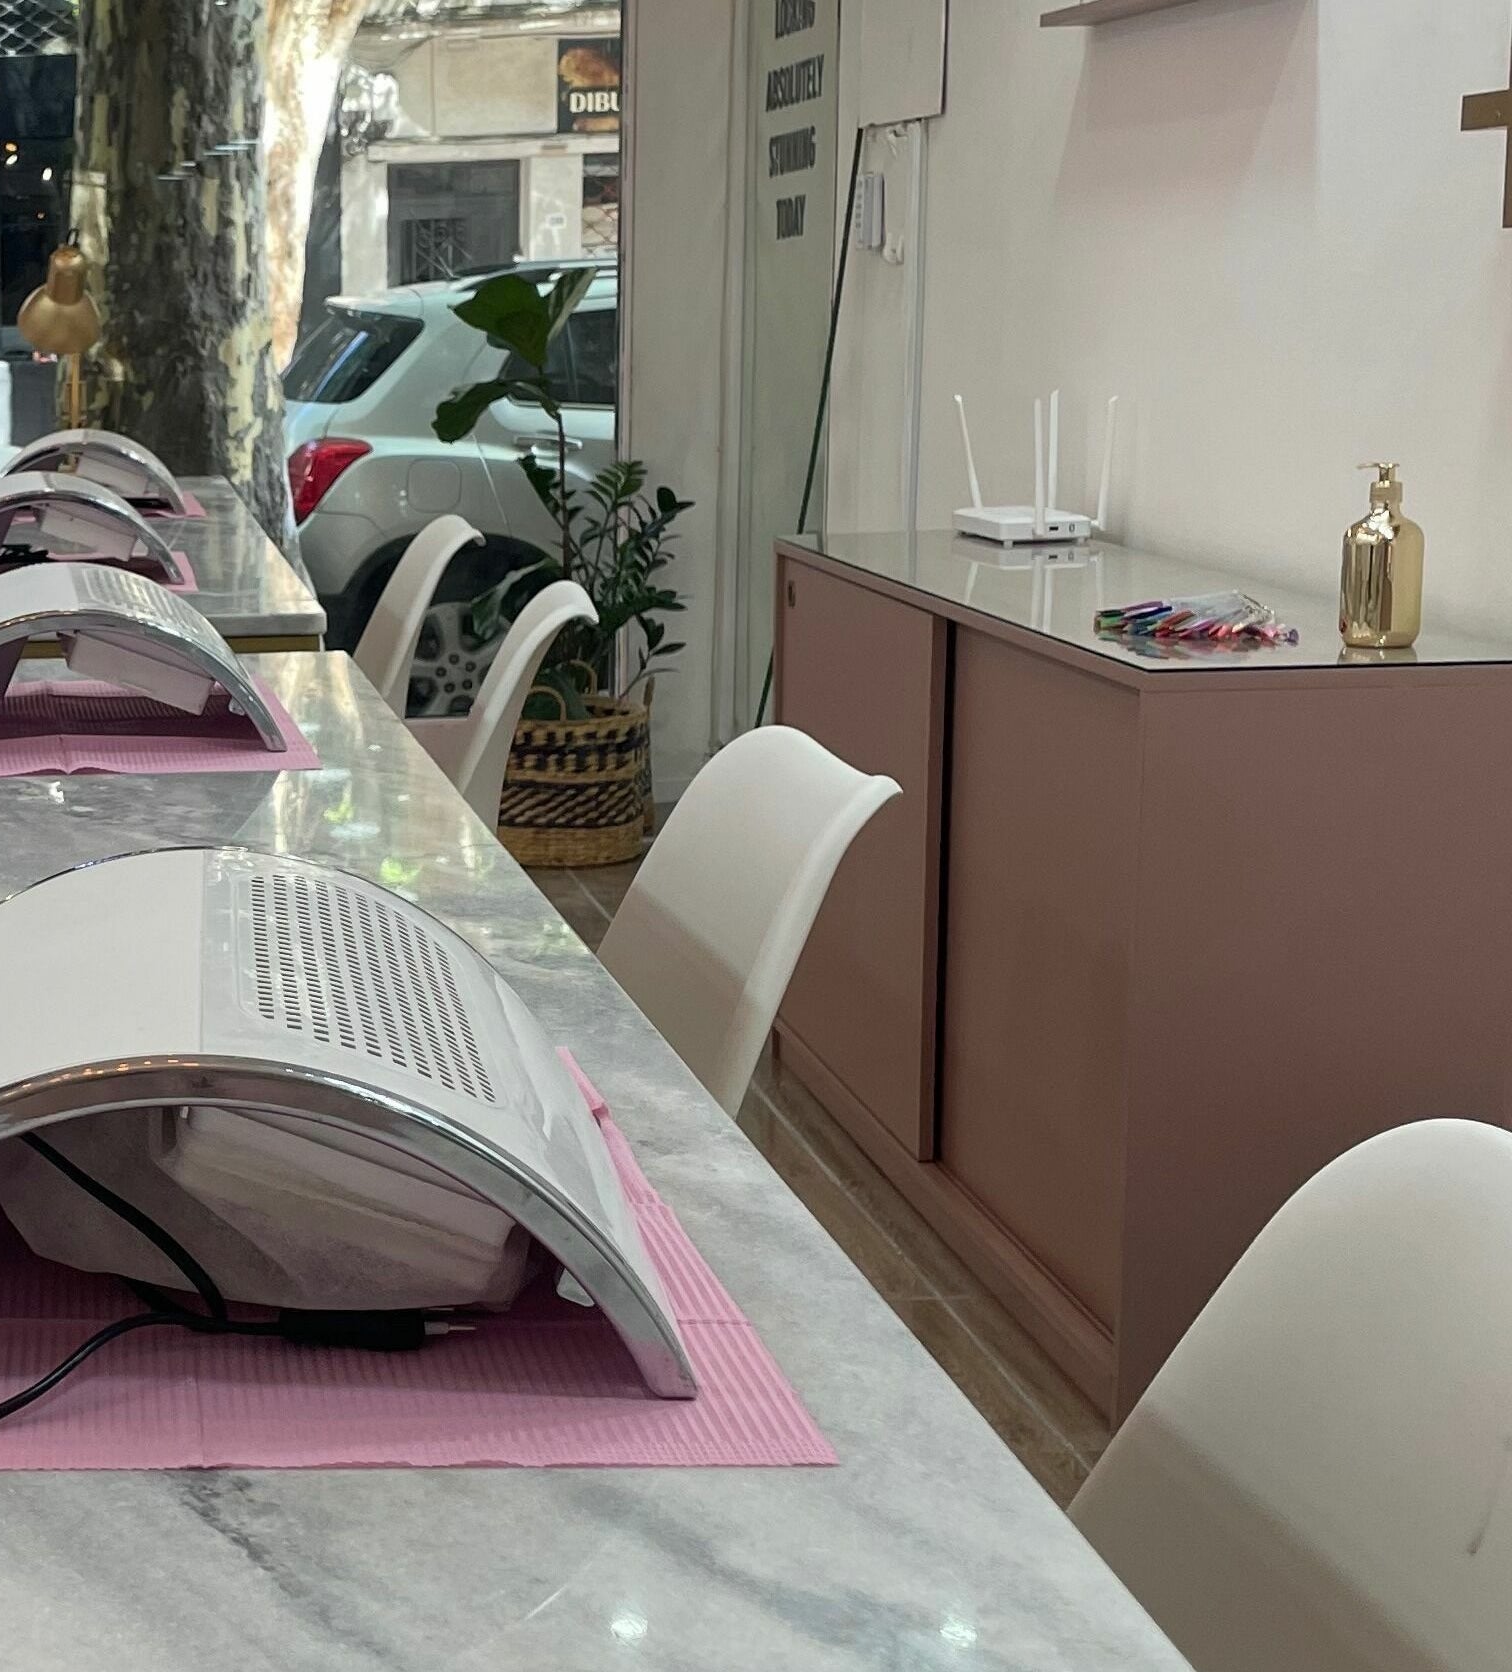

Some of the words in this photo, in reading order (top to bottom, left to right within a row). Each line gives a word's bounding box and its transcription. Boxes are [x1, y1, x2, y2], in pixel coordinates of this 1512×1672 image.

[766, 54, 824, 112] ABSOLUTELY
[769, 126, 816, 179] STUNNING
[776, 194, 806, 240] TODAY
